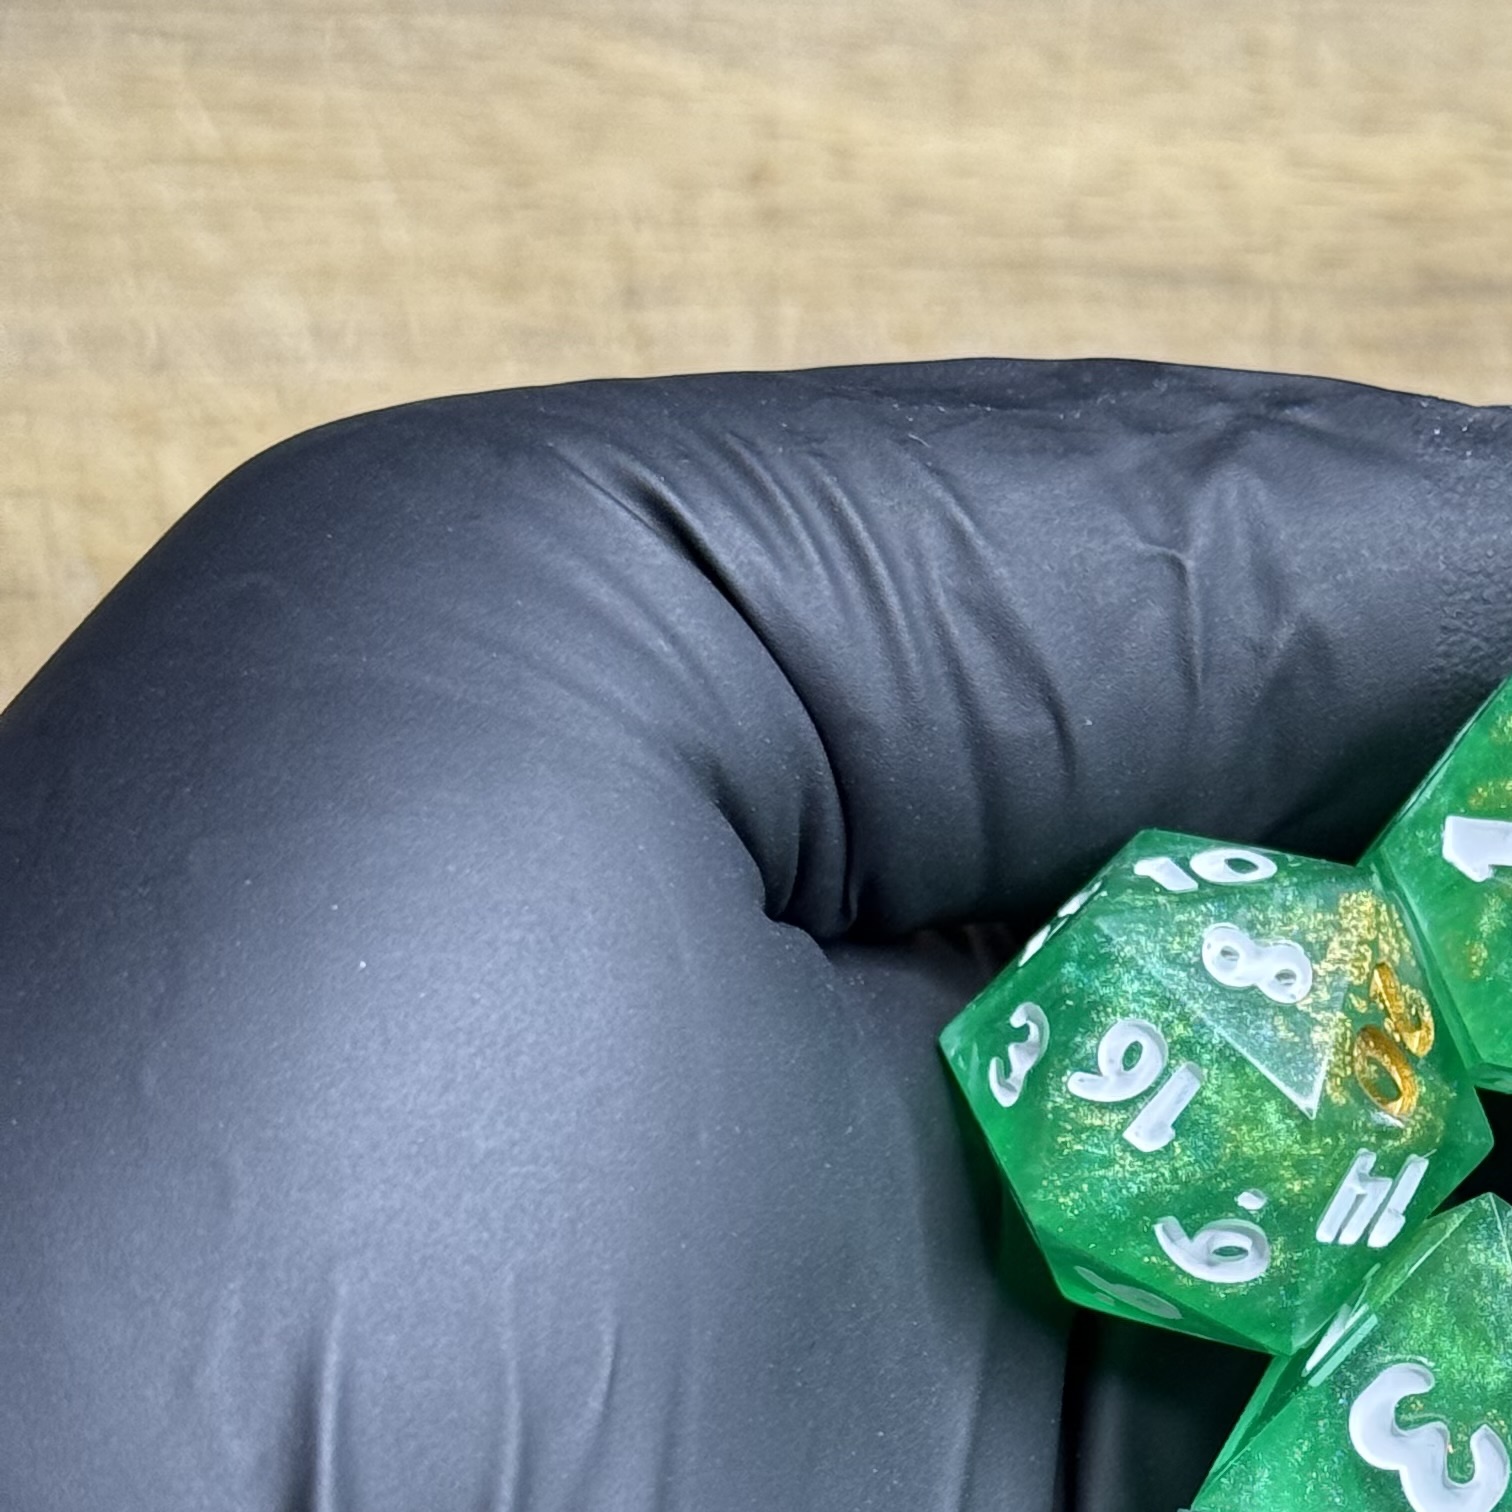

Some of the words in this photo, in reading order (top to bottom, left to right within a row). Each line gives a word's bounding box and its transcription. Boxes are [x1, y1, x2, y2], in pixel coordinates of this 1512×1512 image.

[1132, 847, 1278, 892] 10
[1201, 922, 1313, 1005] 8
[988, 1002, 1051, 1108] 3
[1352, 962, 1435, 1122] 20
[1315, 1147, 1430, 1249] 14
